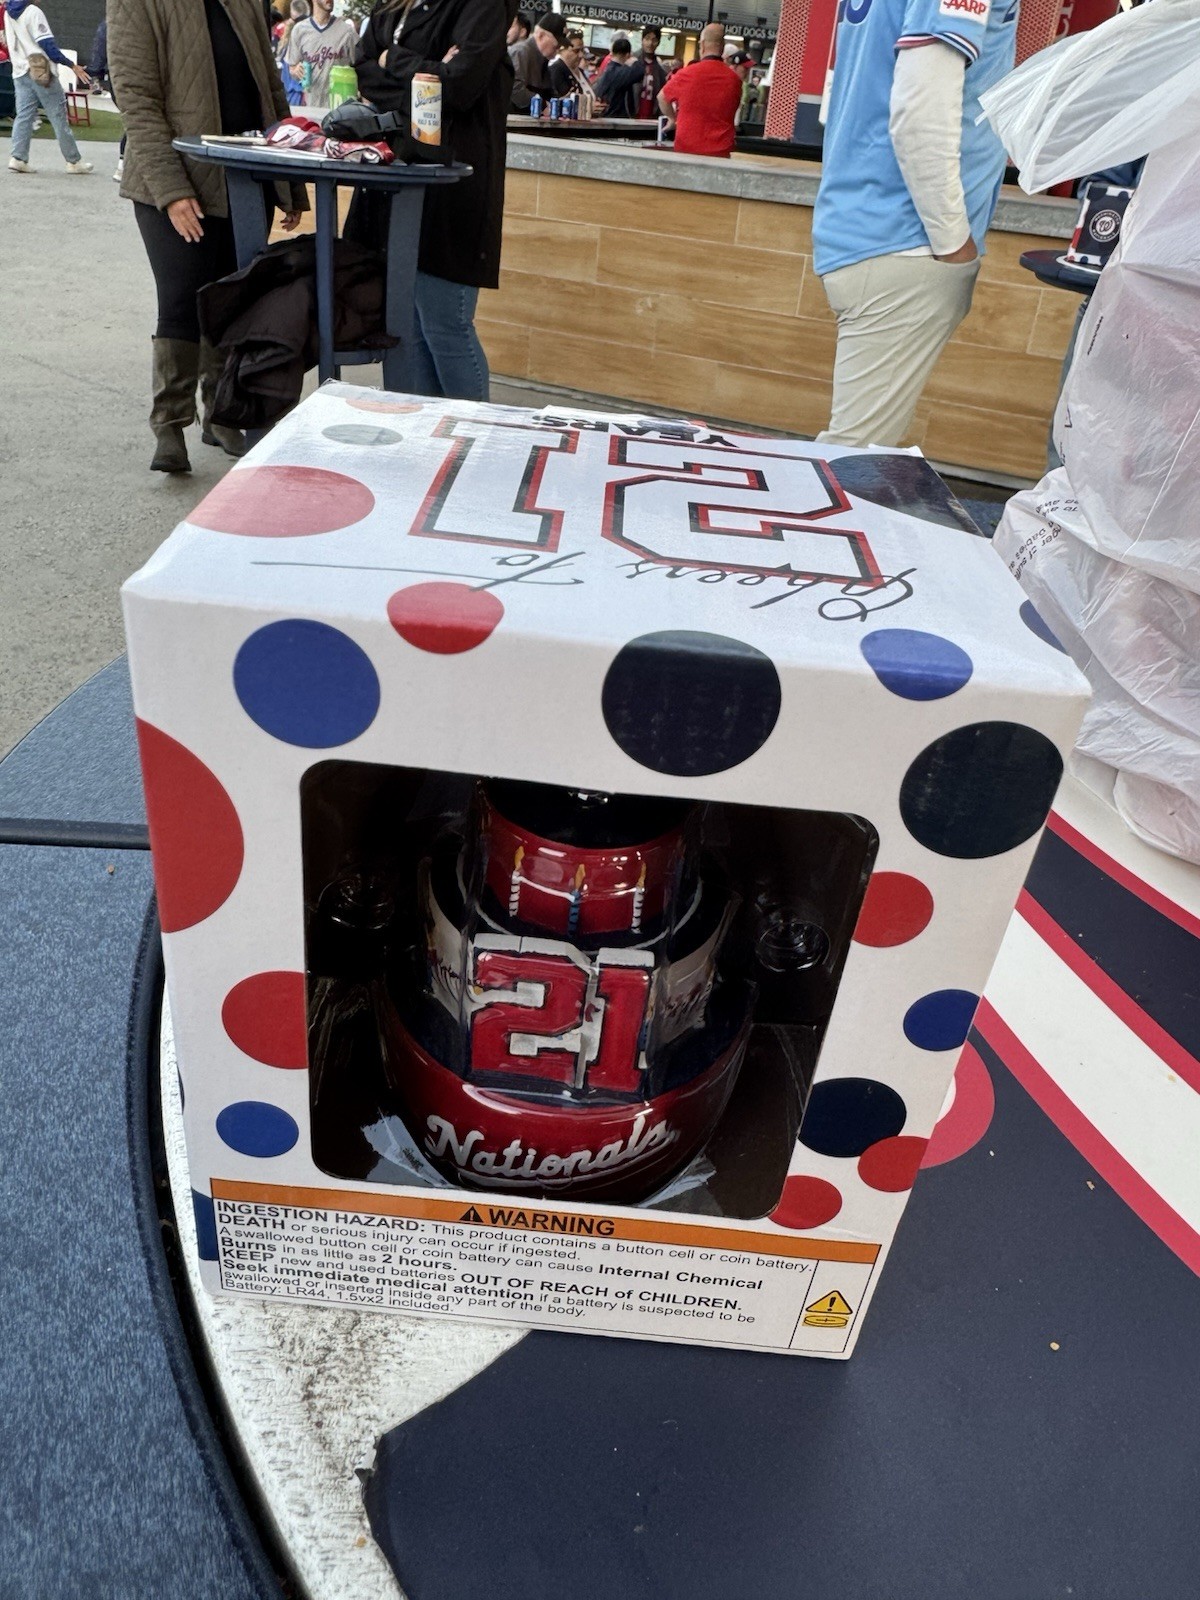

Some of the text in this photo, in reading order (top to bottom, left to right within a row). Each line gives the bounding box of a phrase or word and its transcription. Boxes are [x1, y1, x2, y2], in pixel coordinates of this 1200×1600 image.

[560, 3, 586, 16] AKES
[588, 7, 628, 21] BURGERS
[630, 12, 664, 25] FROZEN
[665, 17, 704, 30] CUSTARD
[725, 25, 742, 35] HOT
[743, 28, 766, 38] DOGS
[408, 415, 882, 588] 21
[615, 556, 919, 622] Cheers
[470, 934, 655, 1097] 21
[425, 1114, 680, 1181] Nationals
[217, 1201, 812, 1273] INGESTION HAZARD: This product contains a button cell or coin battery.
[219, 1213, 581, 1260] DEATH or serious injury can occur if ingested.
[221, 1236, 457, 1271] Burns in as little as 2 hours.
[489, 1208, 616, 1236] WARNING
[219, 1226, 763, 1290] A swallowed button cell or coin battery can cause Internal Chemical
[222, 1247, 742, 1310] KEEP new and used batteries OUT OF REACH of CHILDREN.
[223, 1259, 755, 1324] Seek immediate medical attention if a battery is suspected to be
[224, 1270, 586, 1318] swallowed or inserted inside any part of the body.
[225, 1279, 454, 1312] Battery: LR44, 1.5vx2 included.
